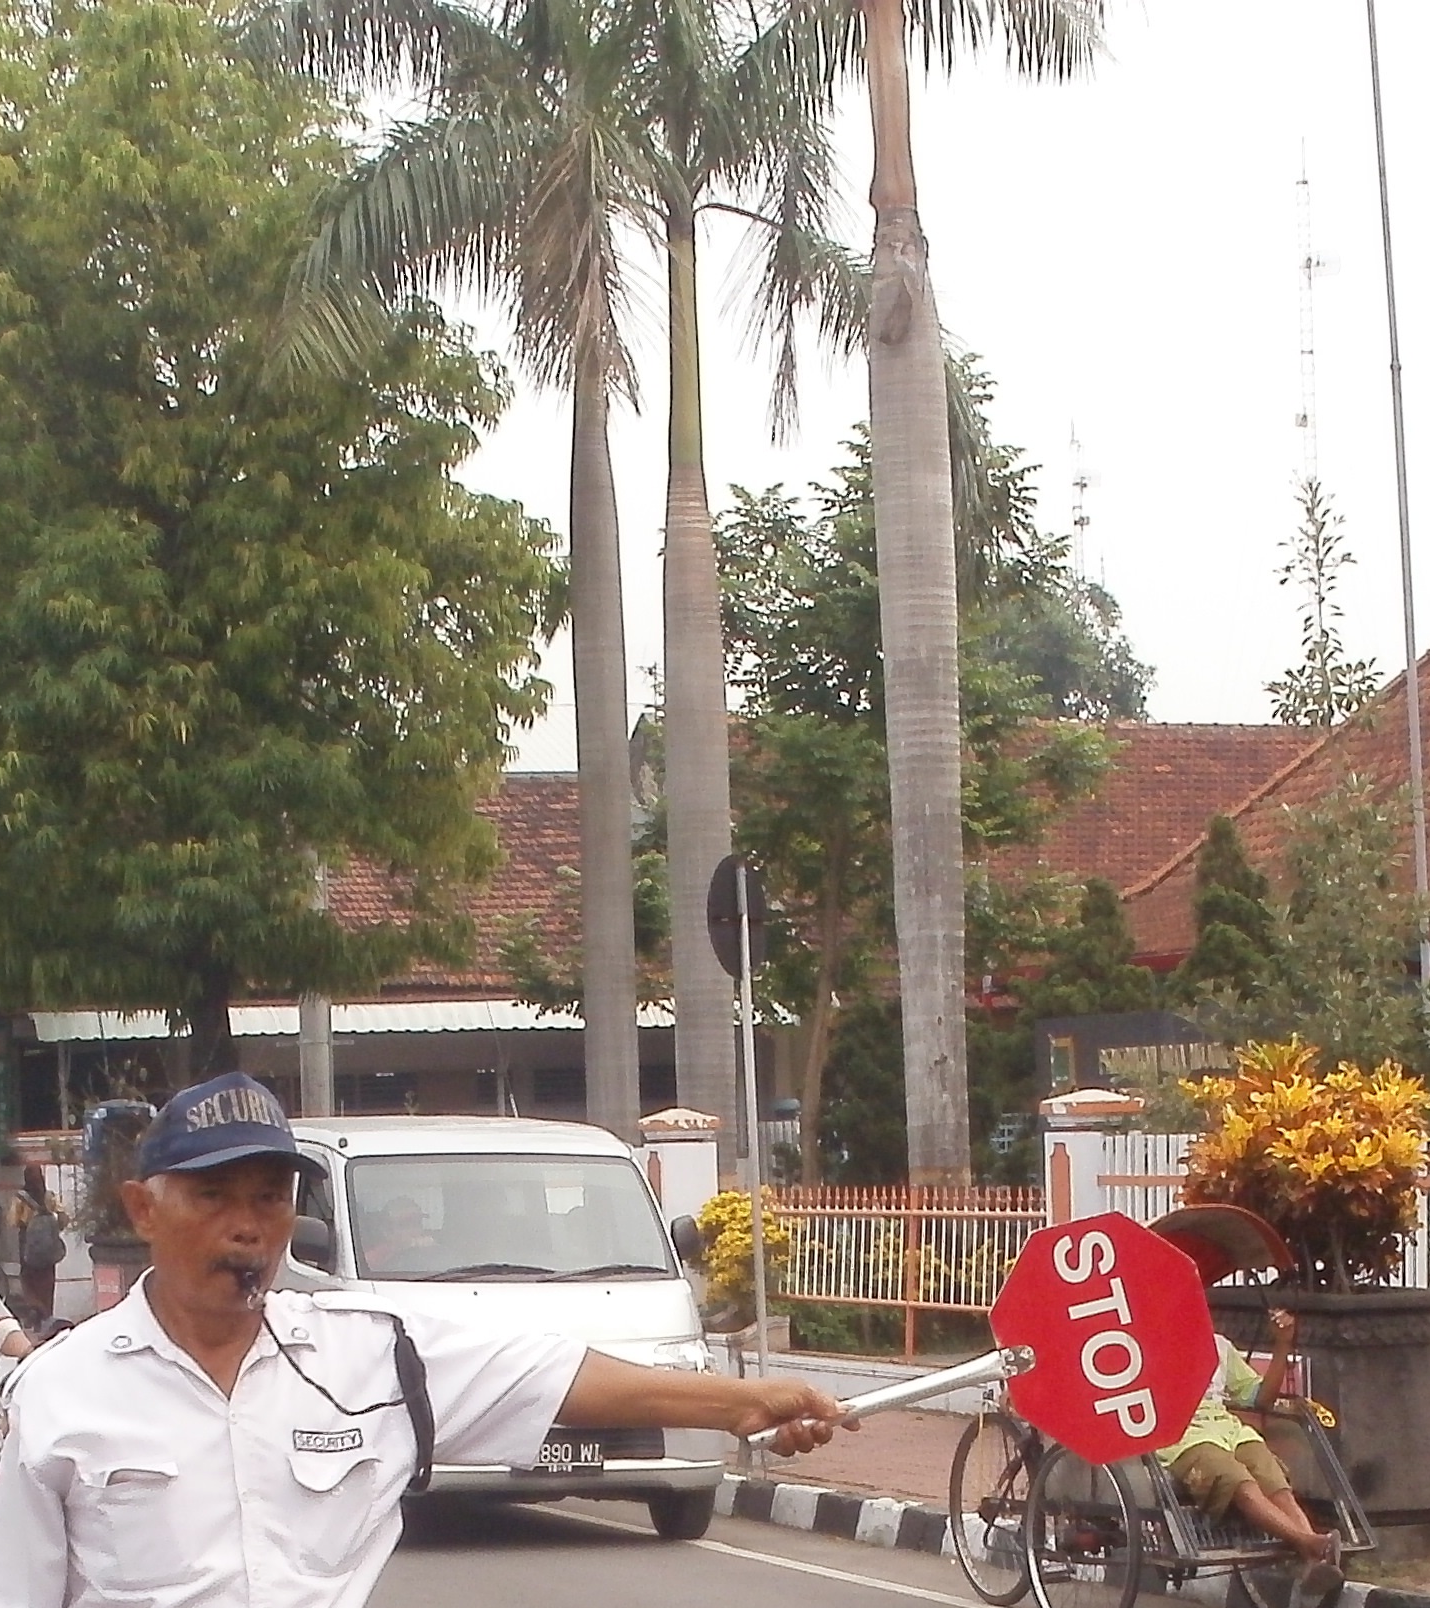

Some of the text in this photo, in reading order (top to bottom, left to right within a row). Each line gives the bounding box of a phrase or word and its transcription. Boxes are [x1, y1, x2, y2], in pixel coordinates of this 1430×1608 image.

[1053, 1231, 1157, 1438] STOP
[297, 1433, 358, 1448] SECURITY
[540, 1443, 572, 1462] 890
